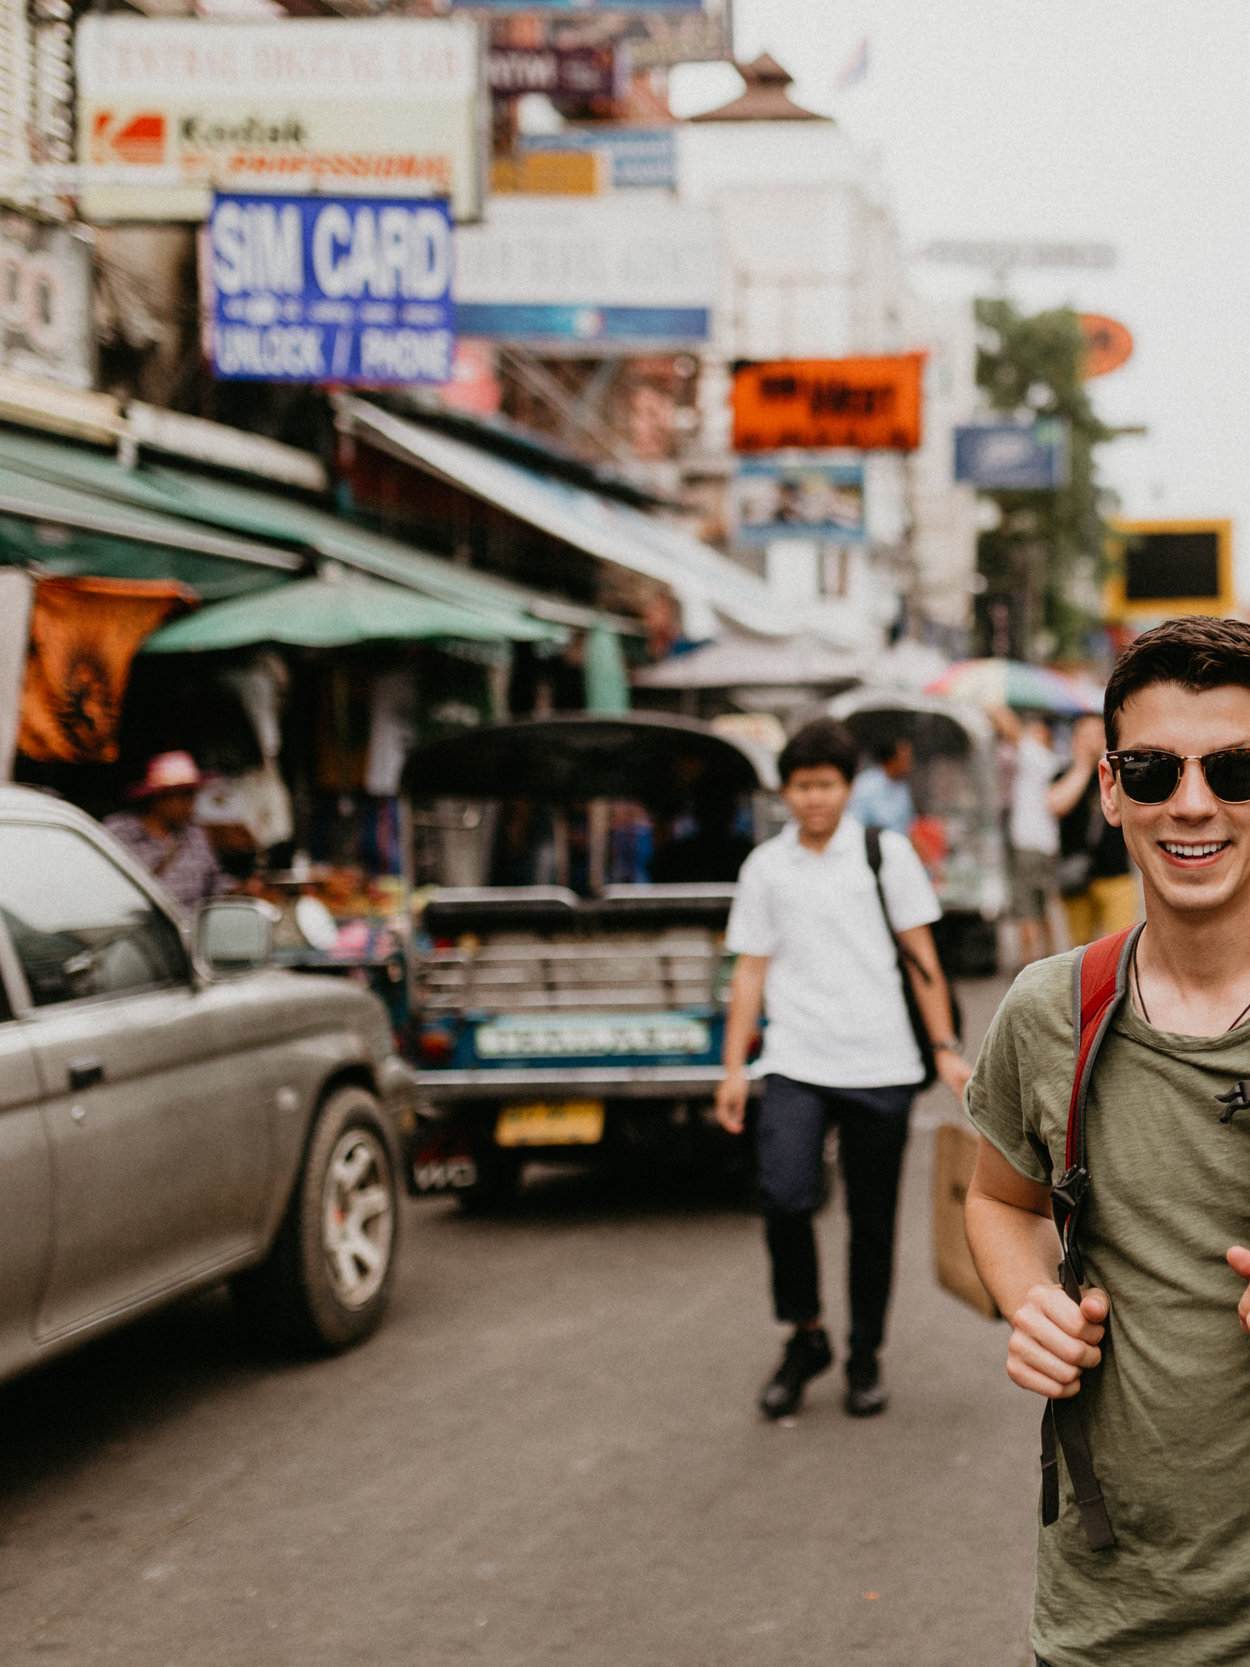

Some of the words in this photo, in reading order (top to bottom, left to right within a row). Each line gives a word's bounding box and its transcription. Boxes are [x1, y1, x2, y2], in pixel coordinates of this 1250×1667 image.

[180, 113, 305, 143] Kodak
[313, 203, 450, 300] CARD
[214, 325, 325, 375] UNLOCK
[361, 327, 451, 379] PHONE
